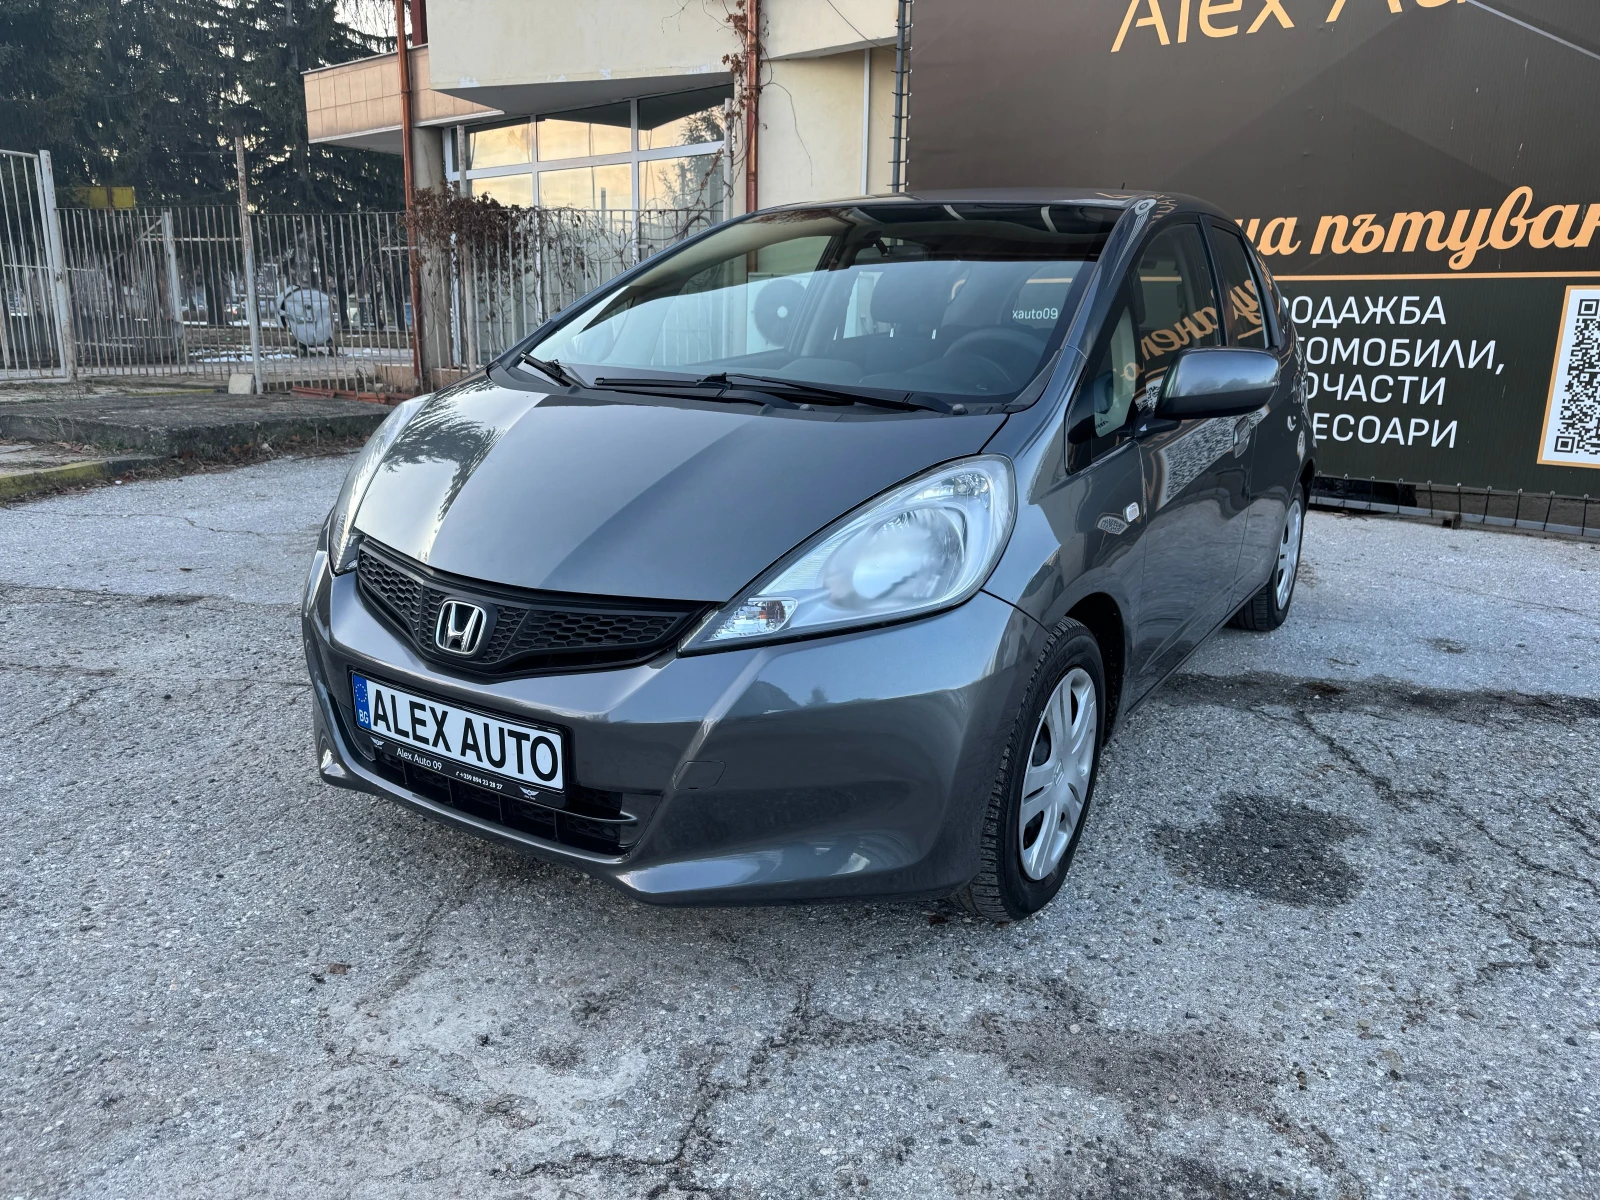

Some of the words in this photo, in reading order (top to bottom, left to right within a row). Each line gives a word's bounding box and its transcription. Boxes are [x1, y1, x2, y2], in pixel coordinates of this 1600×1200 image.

[1299, 336, 1505, 375] ОМОБИЛИ,
[358, 709, 369, 724] BG
[373, 688, 452, 753] ALEX
[460, 717, 559, 782] AUTO
[396, 747, 413, 761] Alex
[413, 753, 432, 767] Auto
[432, 760, 443, 771] 09
